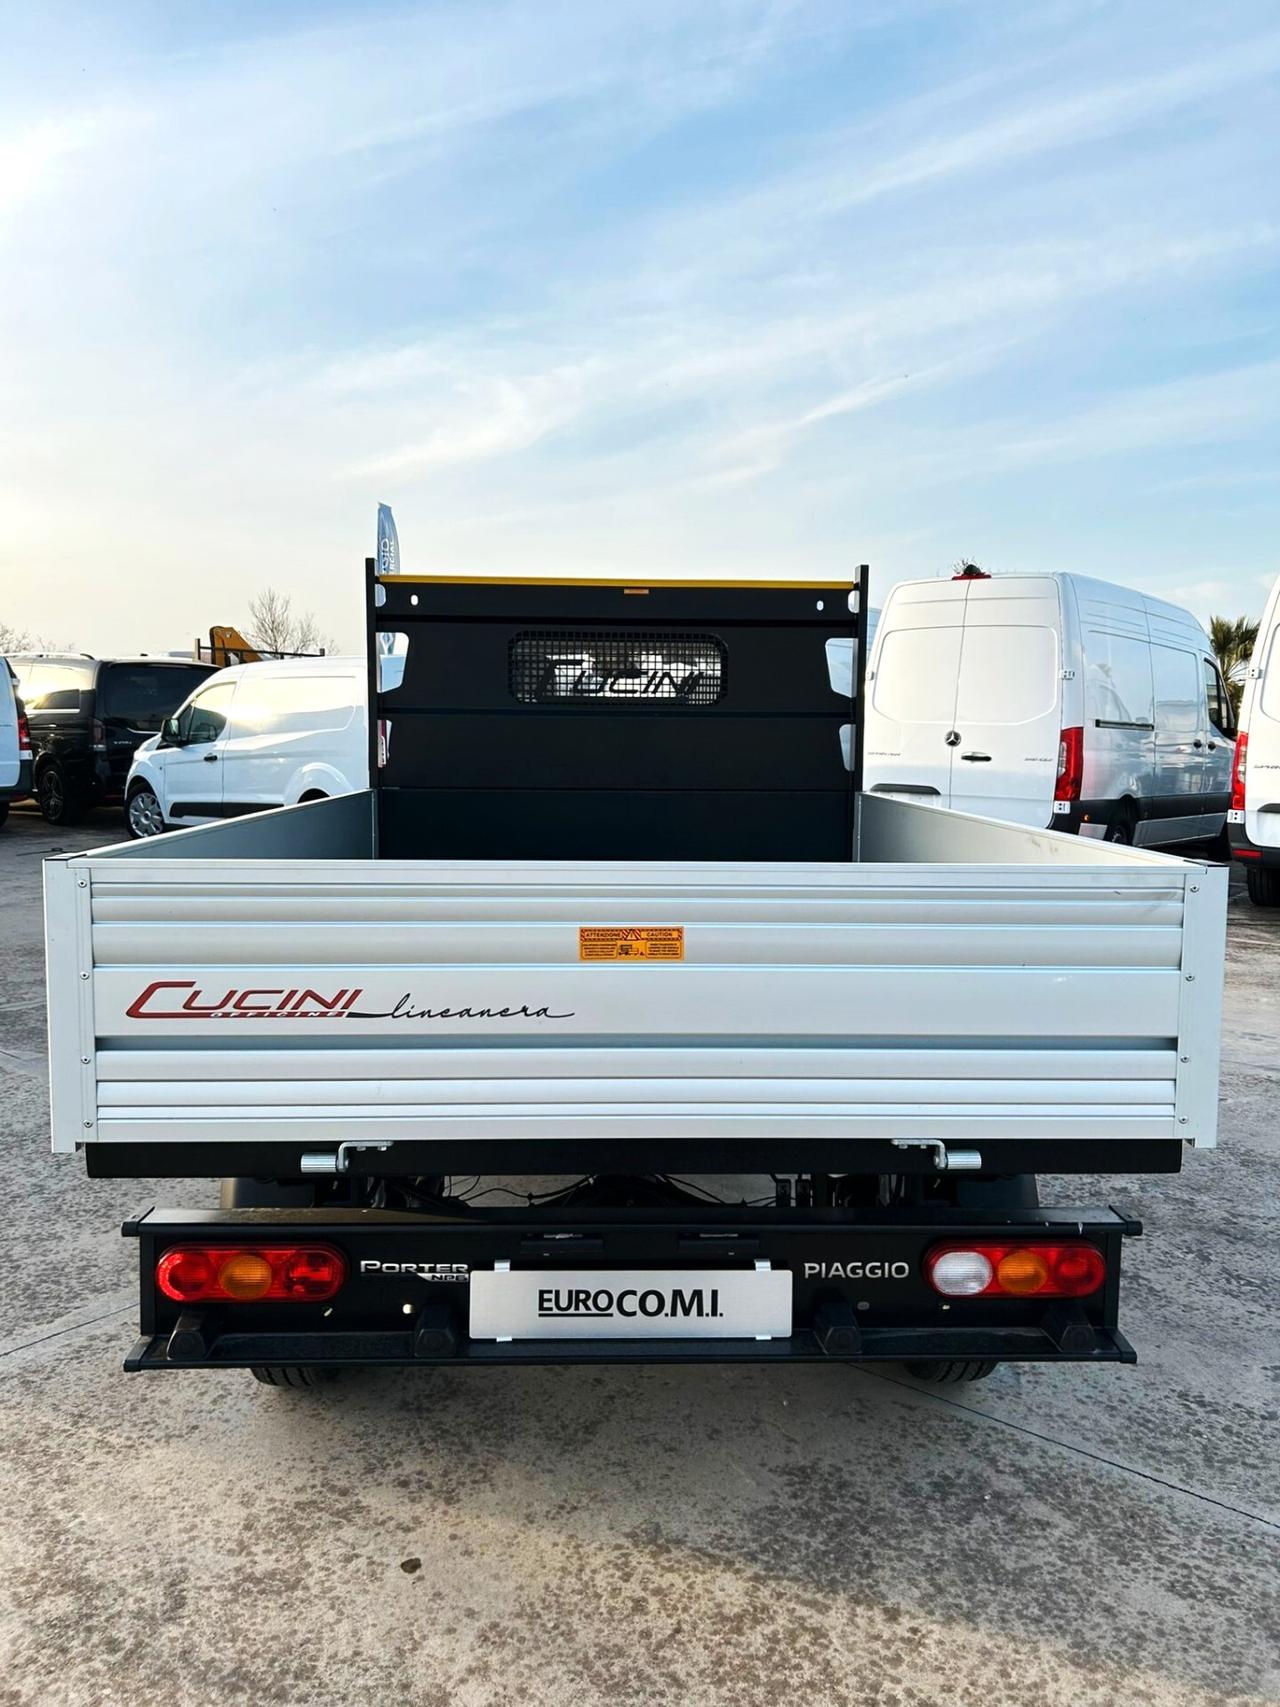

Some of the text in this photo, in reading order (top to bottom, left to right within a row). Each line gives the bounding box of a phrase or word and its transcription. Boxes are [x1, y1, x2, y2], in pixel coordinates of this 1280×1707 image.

[126, 981, 575, 1018] CUCINI lineanera
[360, 1260, 468, 1273] PORTER
[803, 1262, 910, 1278] PIAGGIO
